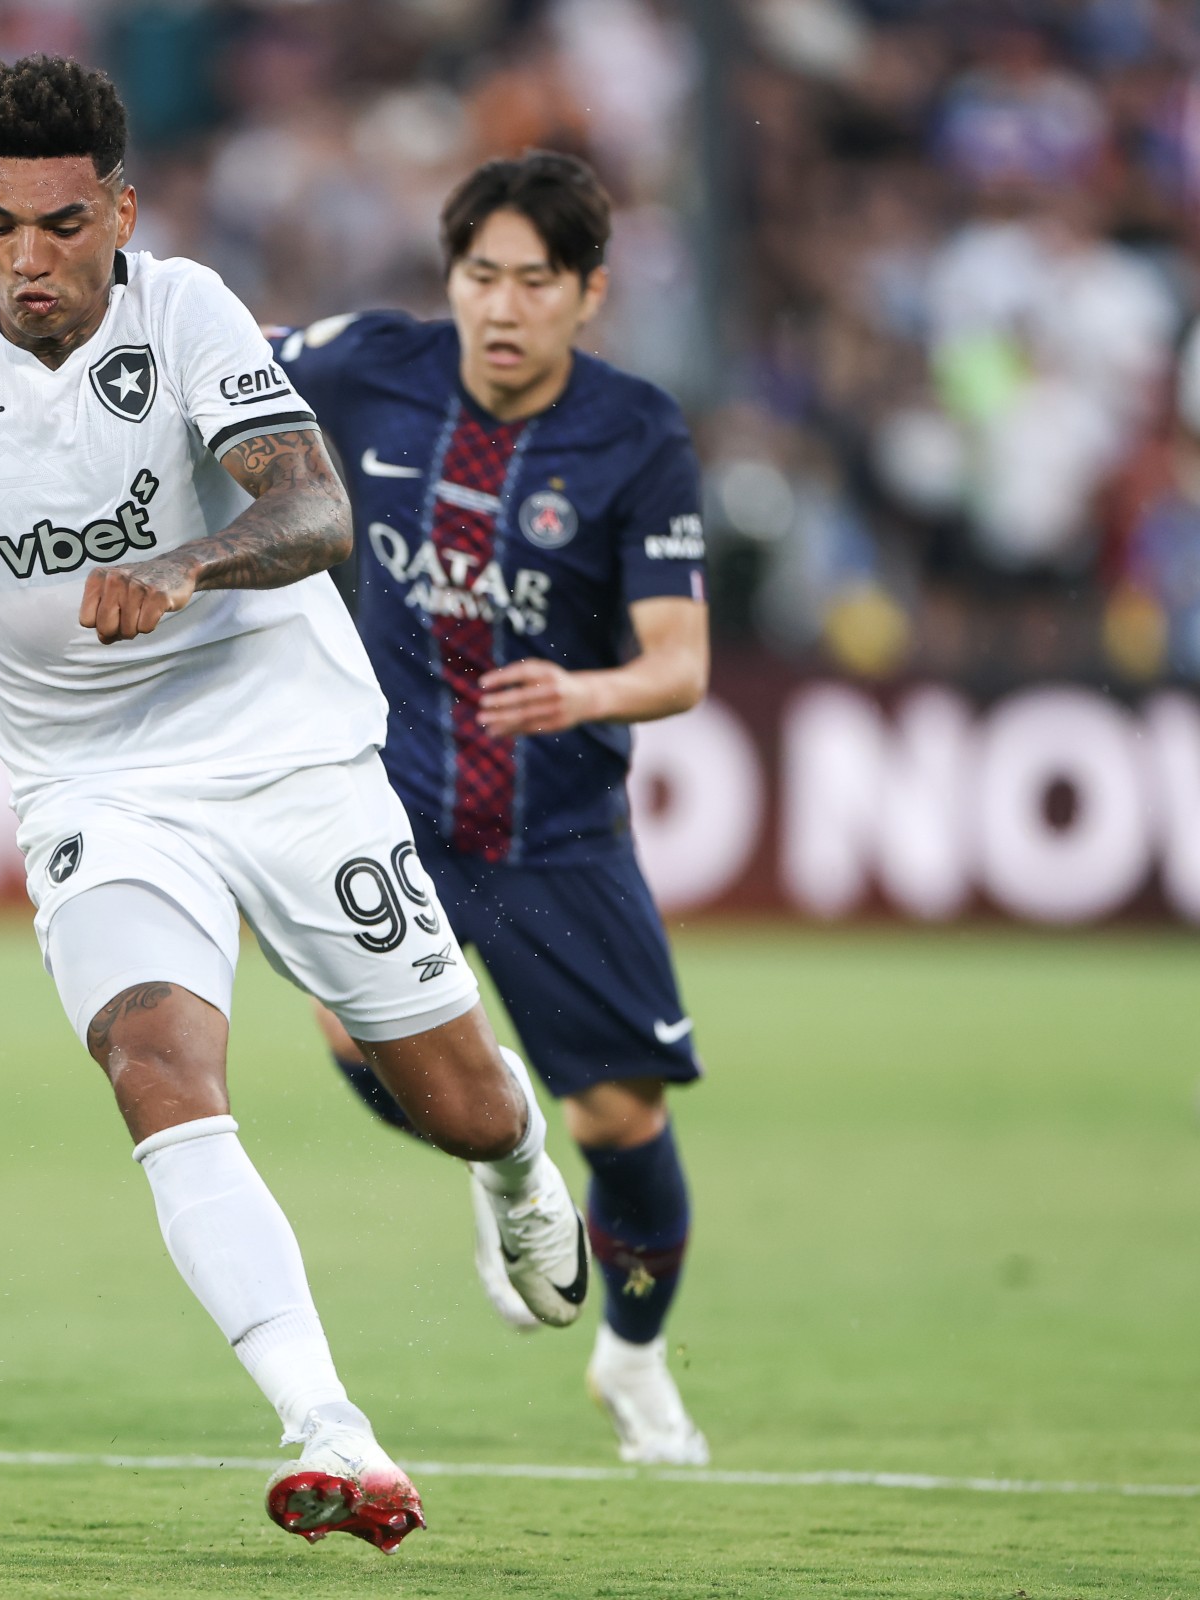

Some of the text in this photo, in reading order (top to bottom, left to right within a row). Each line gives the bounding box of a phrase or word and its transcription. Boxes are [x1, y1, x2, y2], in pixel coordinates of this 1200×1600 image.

[219, 363, 286, 400] Cent
[368, 522, 552, 613] QATAR
[780, 680, 1200, 922] NO
